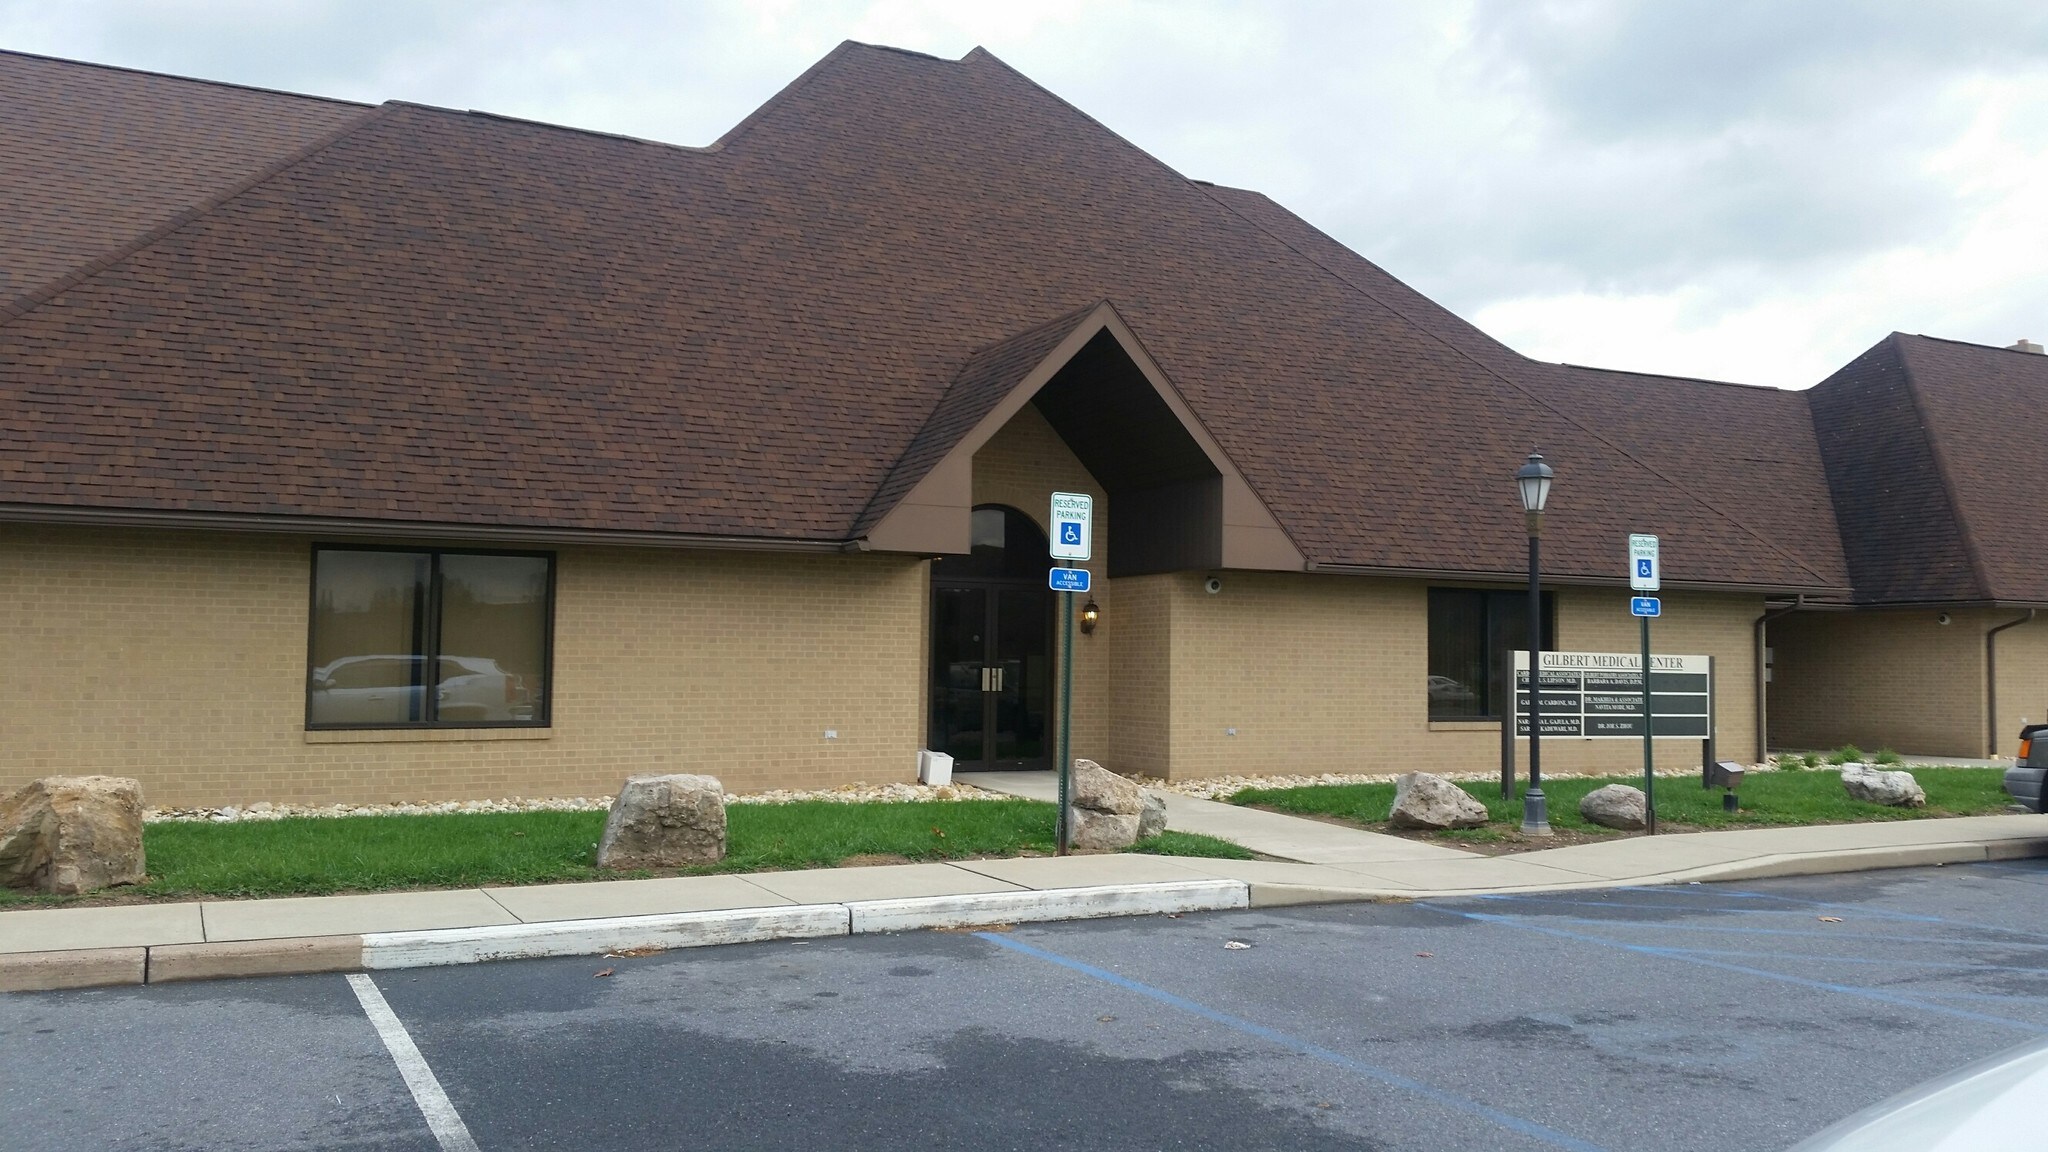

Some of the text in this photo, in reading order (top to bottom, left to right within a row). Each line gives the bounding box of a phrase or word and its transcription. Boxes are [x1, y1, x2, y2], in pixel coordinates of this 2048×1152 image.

[1055, 499, 1089, 510] RESERVED
[1056, 510, 1086, 521] PARKING
[1632, 539, 1657, 547] RESERVED
[1634, 548, 1655, 557] PARKING
[1062, 572, 1078, 581] VAN
[1056, 580, 1084, 588] ACCESSIBLE
[683, 654, 1649, 669] GILBERT MEDICAL ENTER
